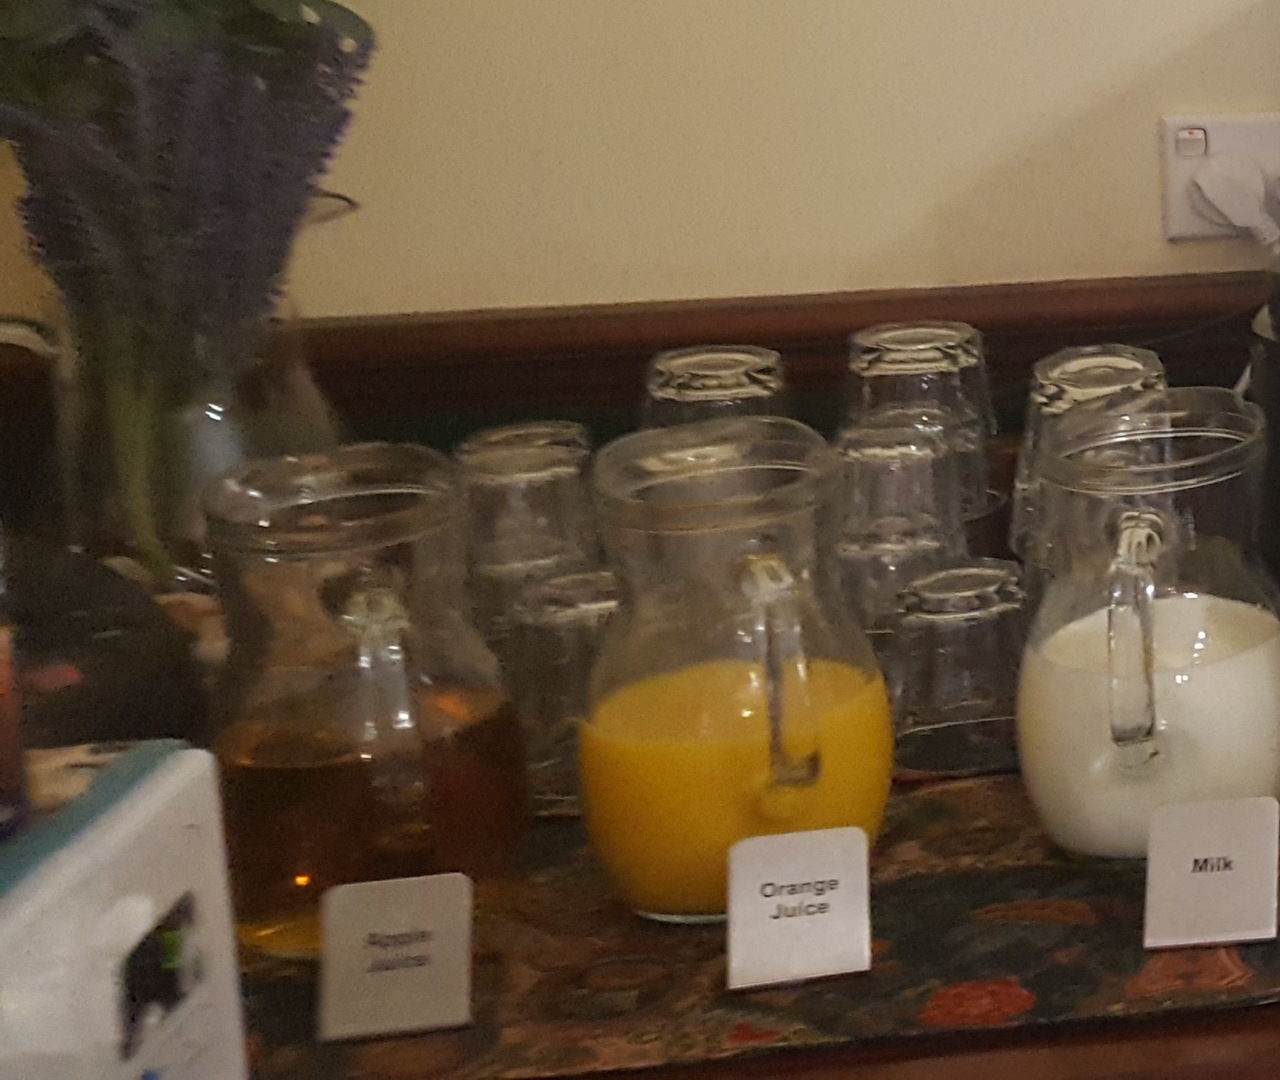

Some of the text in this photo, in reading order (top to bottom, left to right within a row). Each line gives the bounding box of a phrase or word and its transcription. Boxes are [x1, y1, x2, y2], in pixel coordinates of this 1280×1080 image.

[1191, 856, 1233, 873] Milk
[760, 879, 839, 898] Orange
[768, 902, 830, 919] Juice
